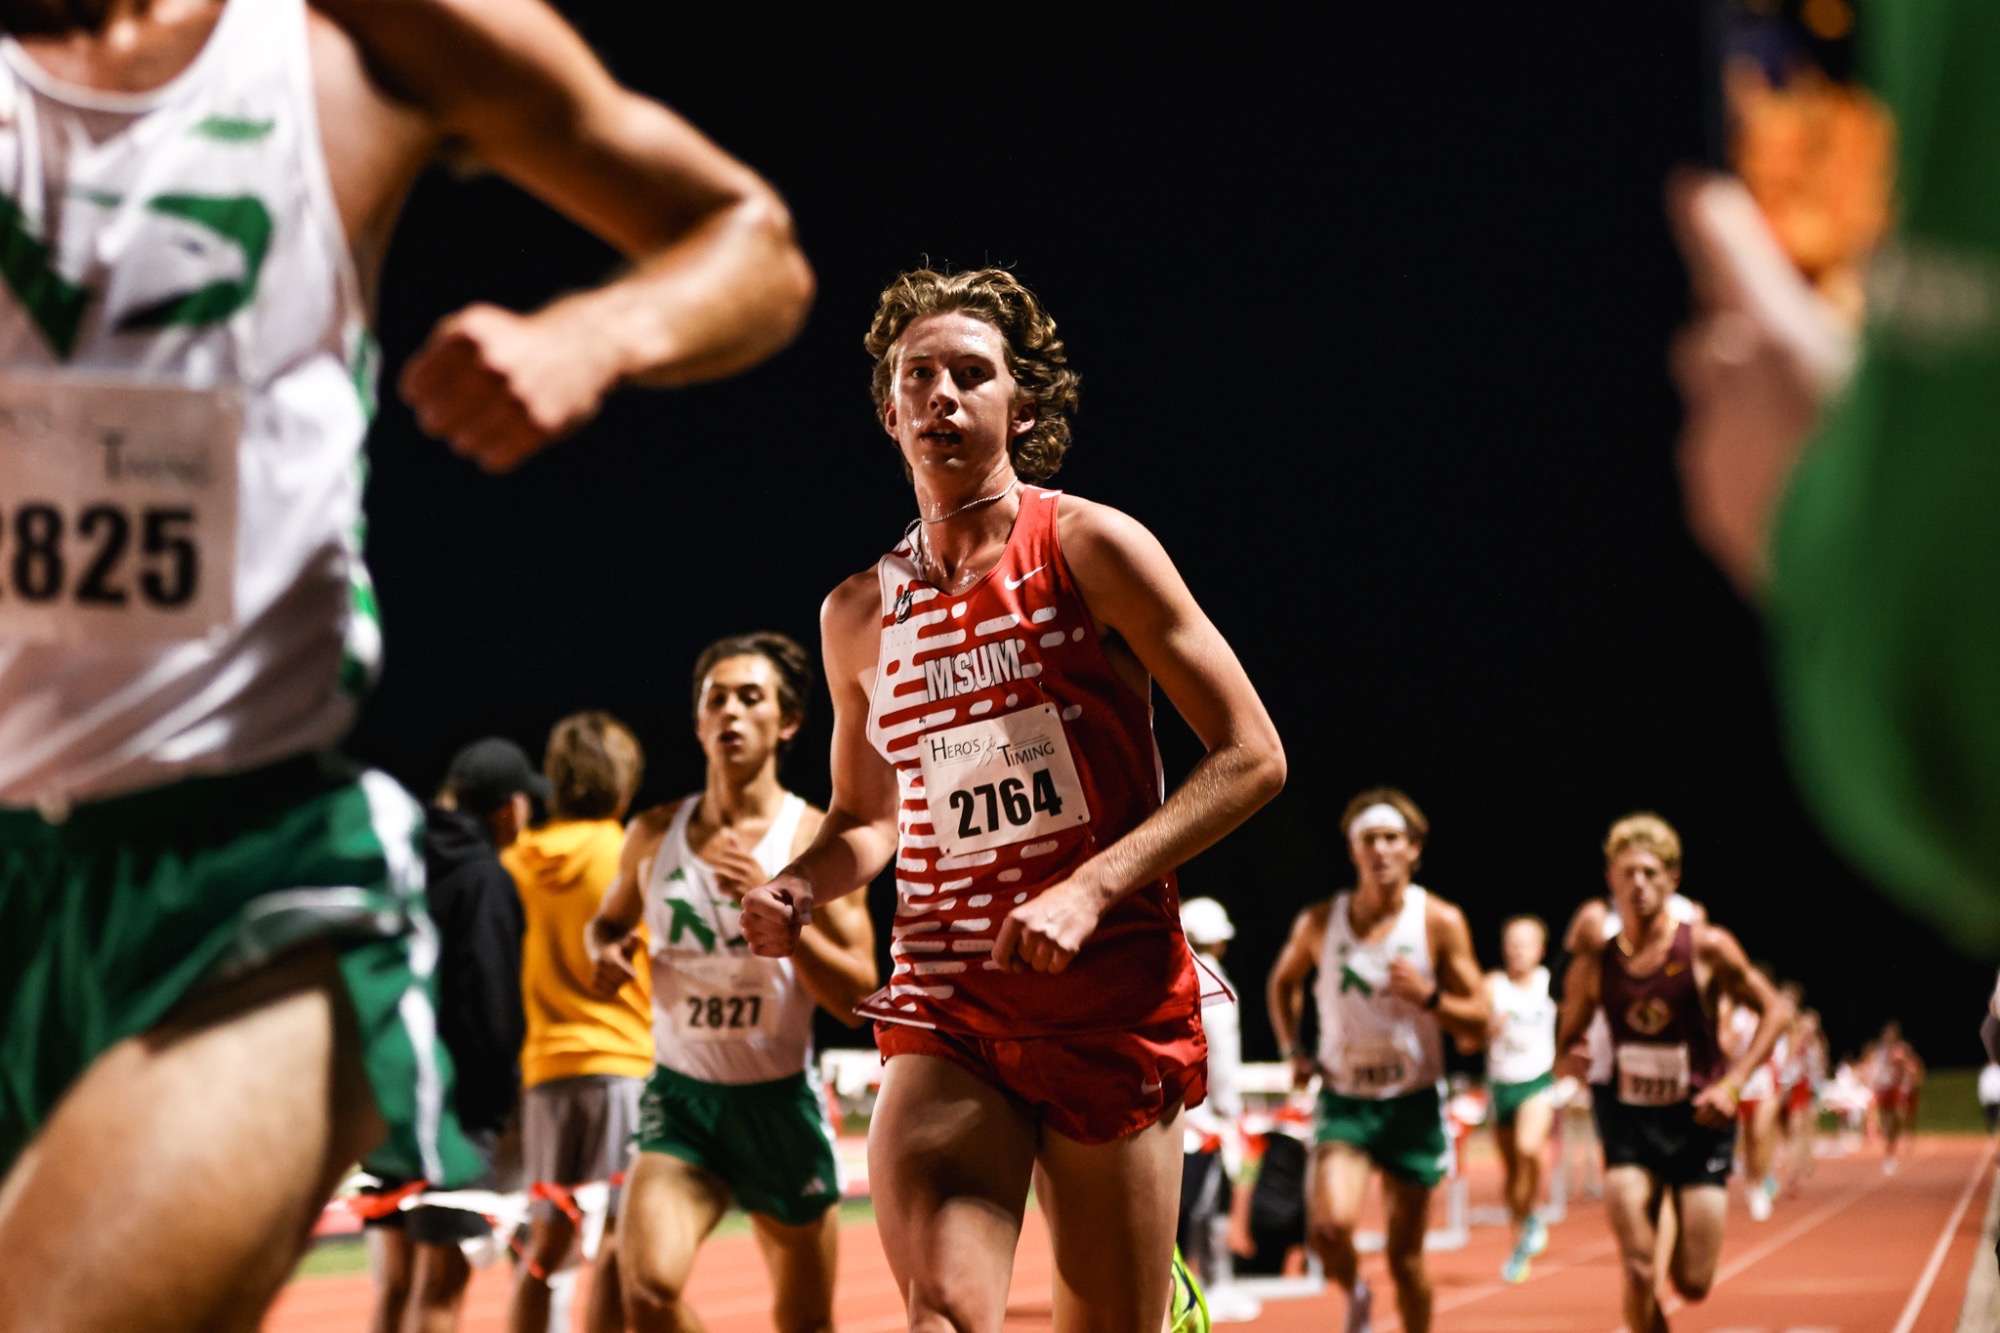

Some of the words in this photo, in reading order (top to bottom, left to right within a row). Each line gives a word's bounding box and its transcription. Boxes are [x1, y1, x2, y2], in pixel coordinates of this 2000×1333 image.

[0, 501, 200, 610] 825
[924, 638, 1023, 702] MSUM
[997, 741, 1055, 767] TIMING
[949, 768, 1063, 839] 2764
[687, 995, 762, 1029] 2827
